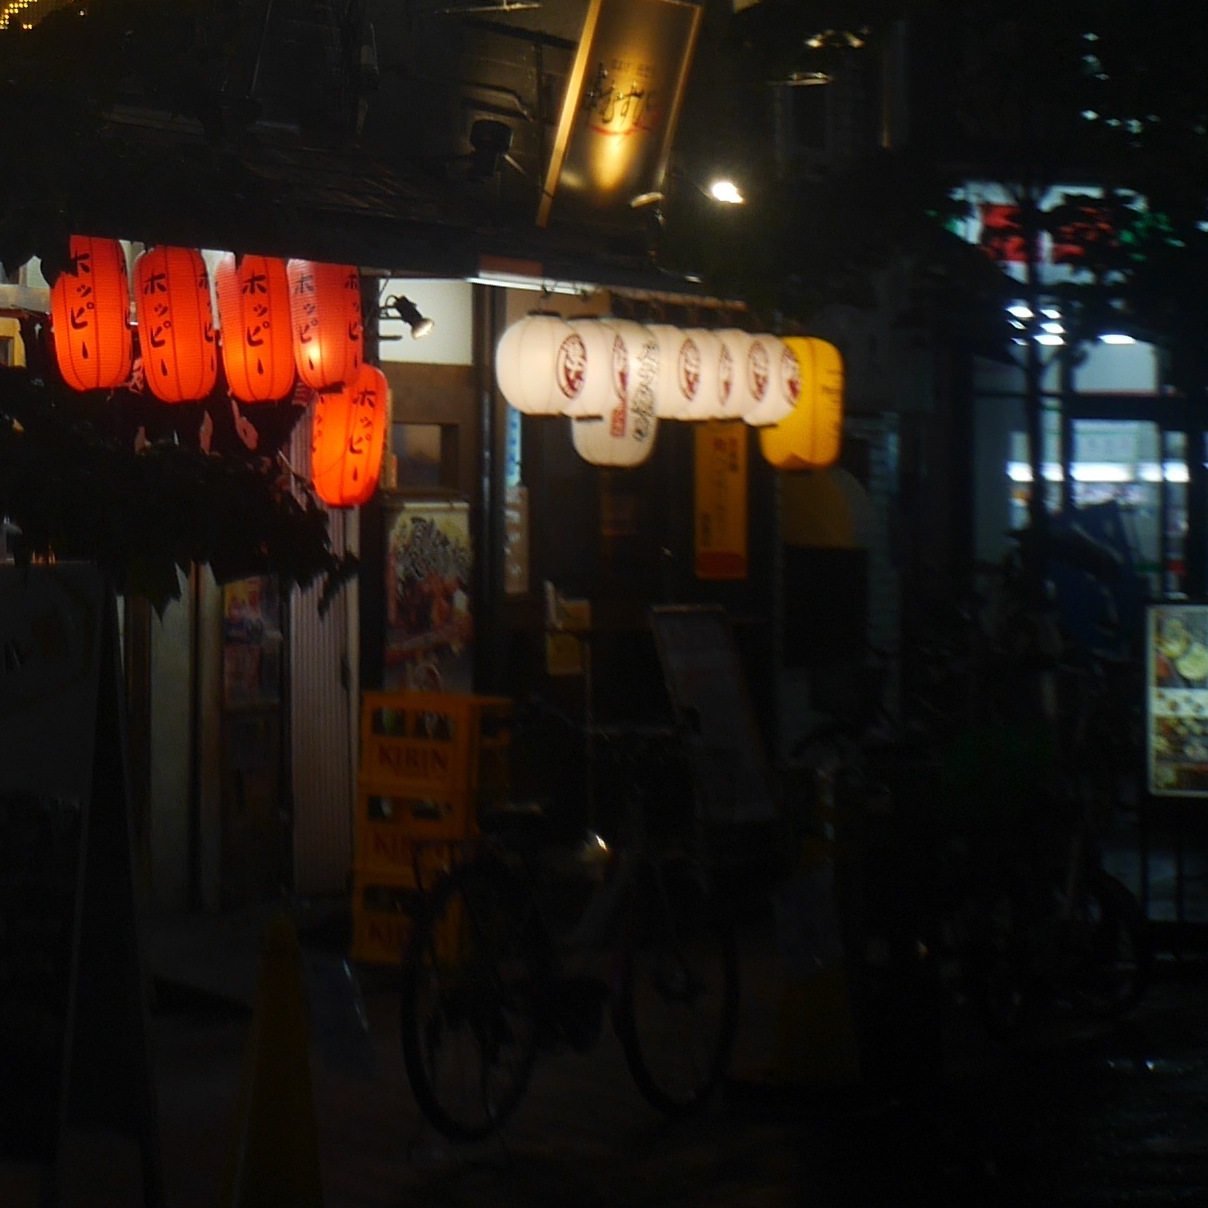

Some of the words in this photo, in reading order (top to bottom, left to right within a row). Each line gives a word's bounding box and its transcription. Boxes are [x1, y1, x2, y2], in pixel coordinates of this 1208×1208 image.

[142, 268, 173, 361] ホッピー
[241, 269, 271, 376] ホッピー
[294, 273, 319, 372] ホッピー
[351, 389, 377, 480] ホッピー
[377, 743, 449, 772] KIRIN
